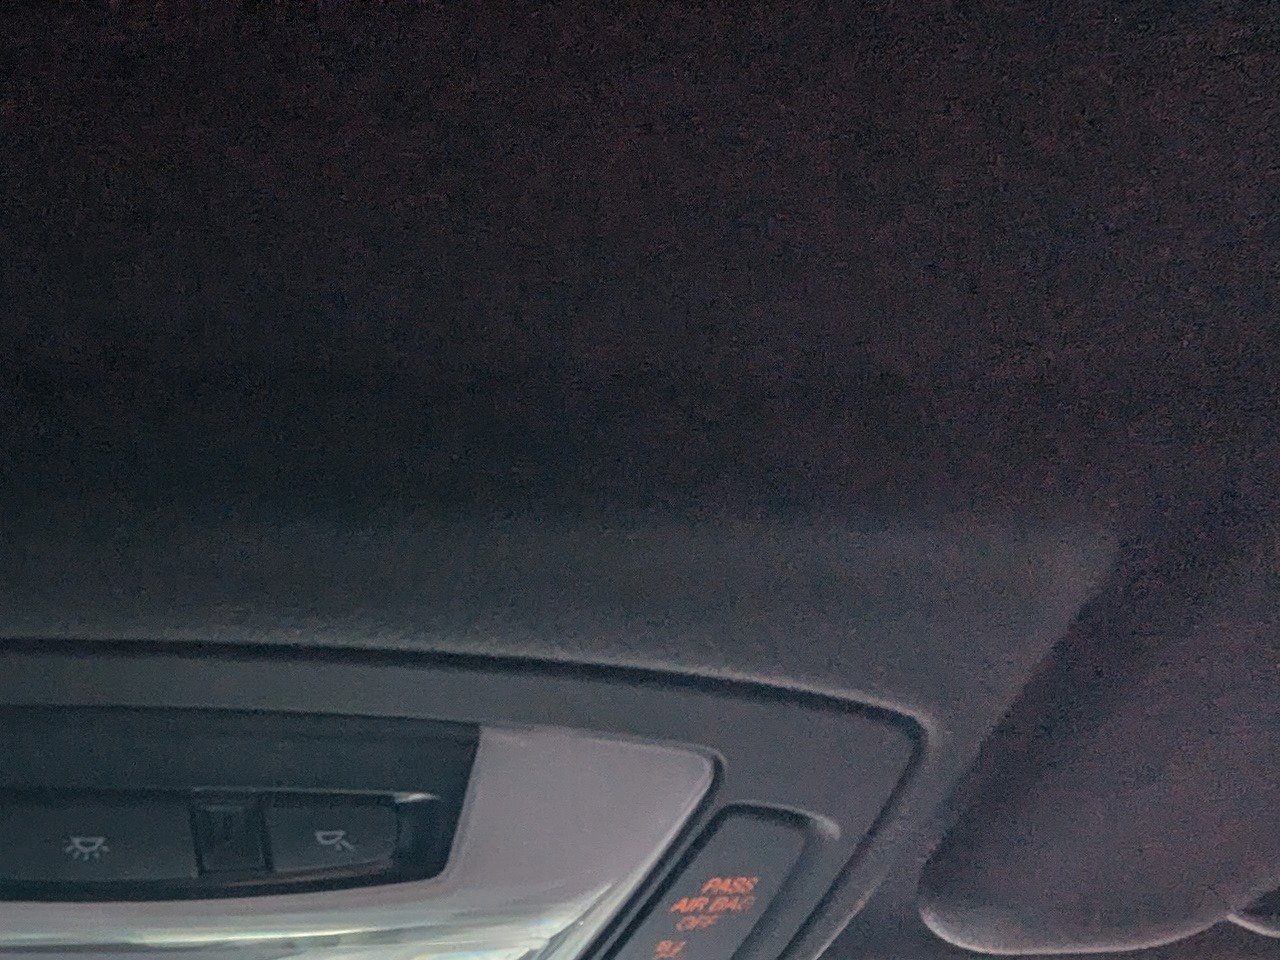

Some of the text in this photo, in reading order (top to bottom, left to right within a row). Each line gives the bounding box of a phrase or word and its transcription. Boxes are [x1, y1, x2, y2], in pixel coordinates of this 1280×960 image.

[702, 876, 759, 894] PASS
[670, 896, 756, 913] AIR BAG
